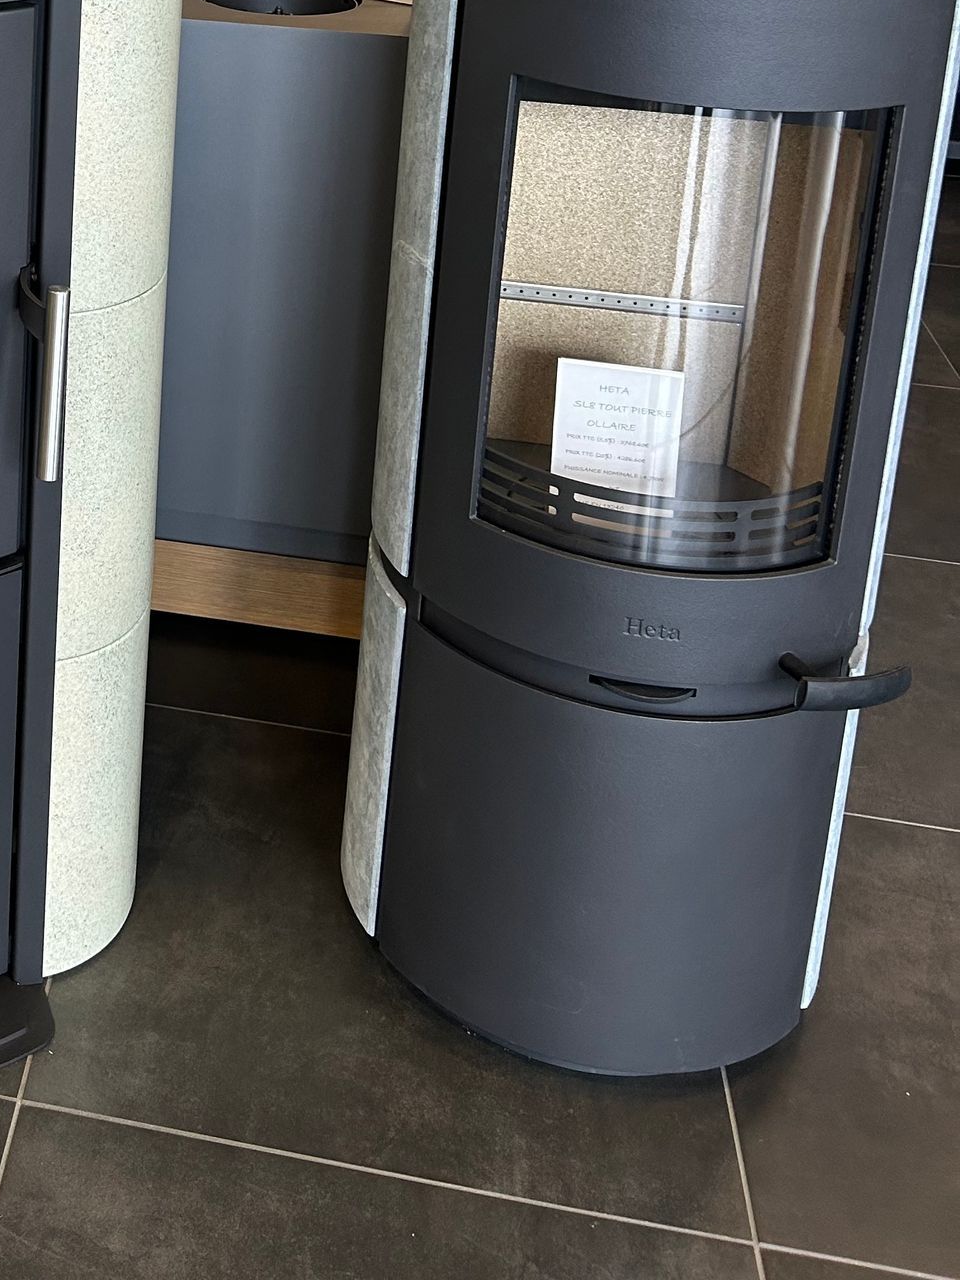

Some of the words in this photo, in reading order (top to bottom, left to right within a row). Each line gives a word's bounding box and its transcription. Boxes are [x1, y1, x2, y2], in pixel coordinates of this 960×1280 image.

[599, 384, 630, 395] HETA
[572, 400, 596, 409] SL8
[598, 402, 630, 413] TOUT
[631, 406, 672, 418] PIERRE
[586, 419, 637, 432] OLLAIRE
[623, 615, 681, 642] Heta
